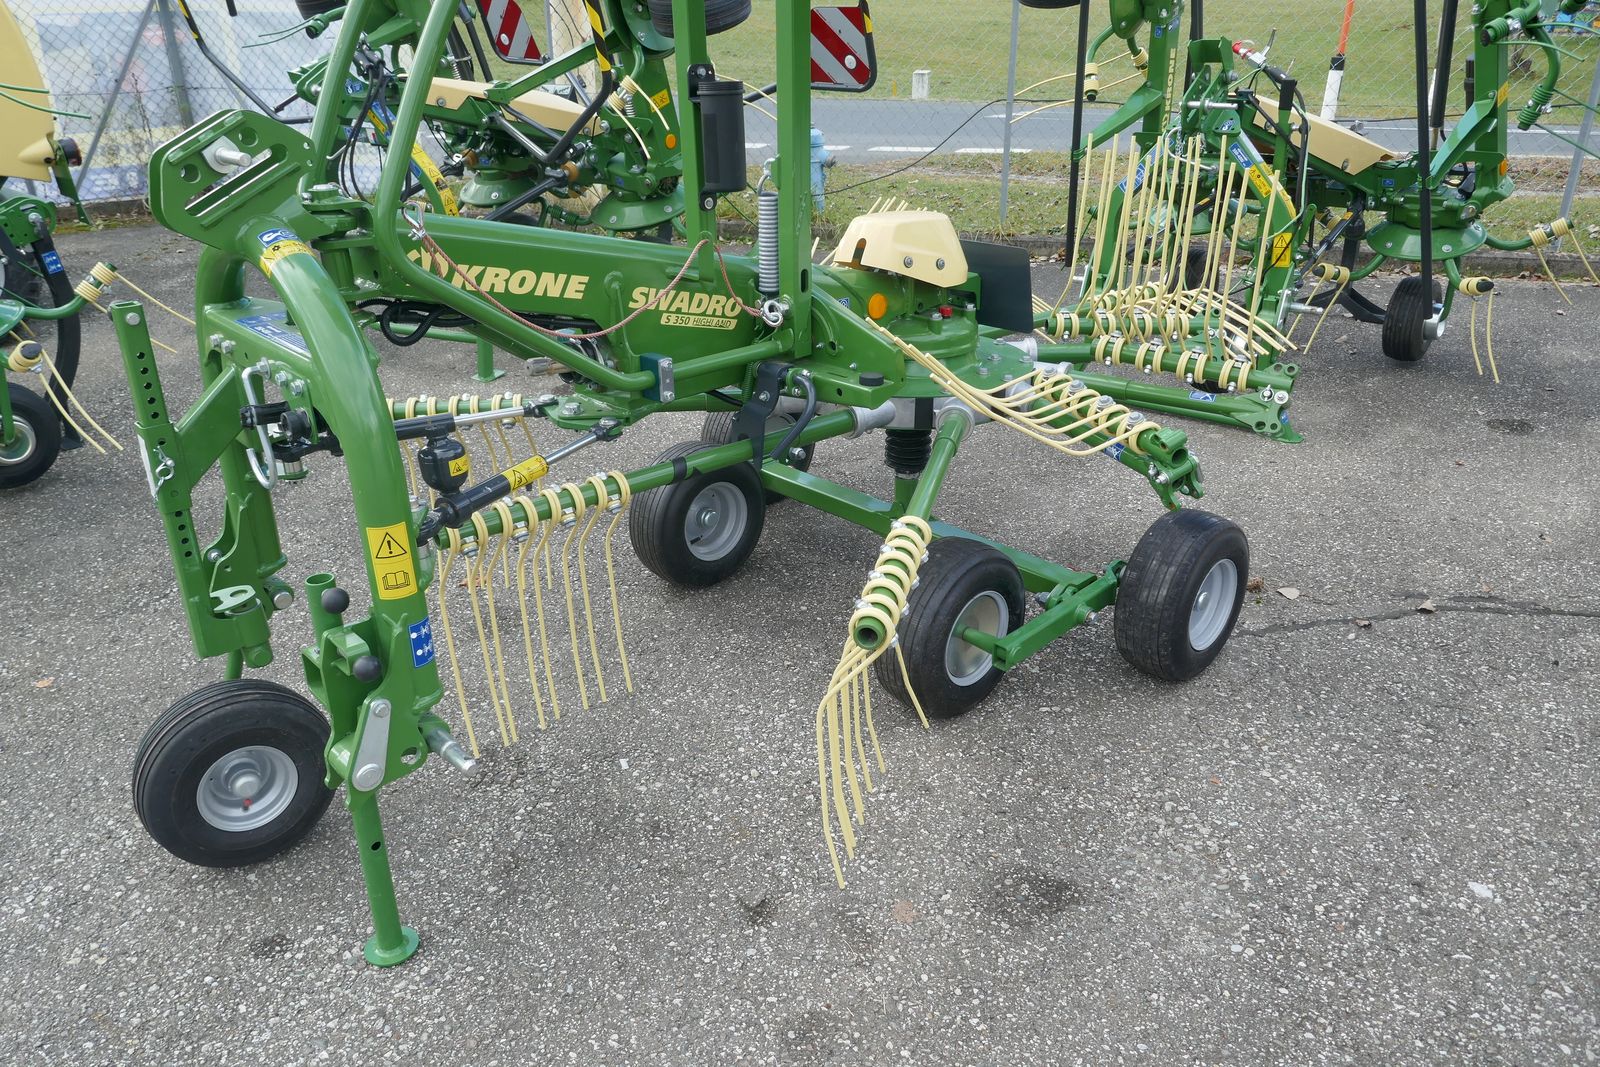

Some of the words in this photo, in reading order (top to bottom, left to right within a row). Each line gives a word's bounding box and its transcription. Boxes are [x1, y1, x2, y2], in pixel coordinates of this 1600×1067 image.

[451, 263, 589, 300] KRONE
[628, 286, 743, 318] SWADRO
[664, 314, 672, 324] S
[673, 315, 690, 325] 350
[692, 317, 732, 328] HIGHLAND
